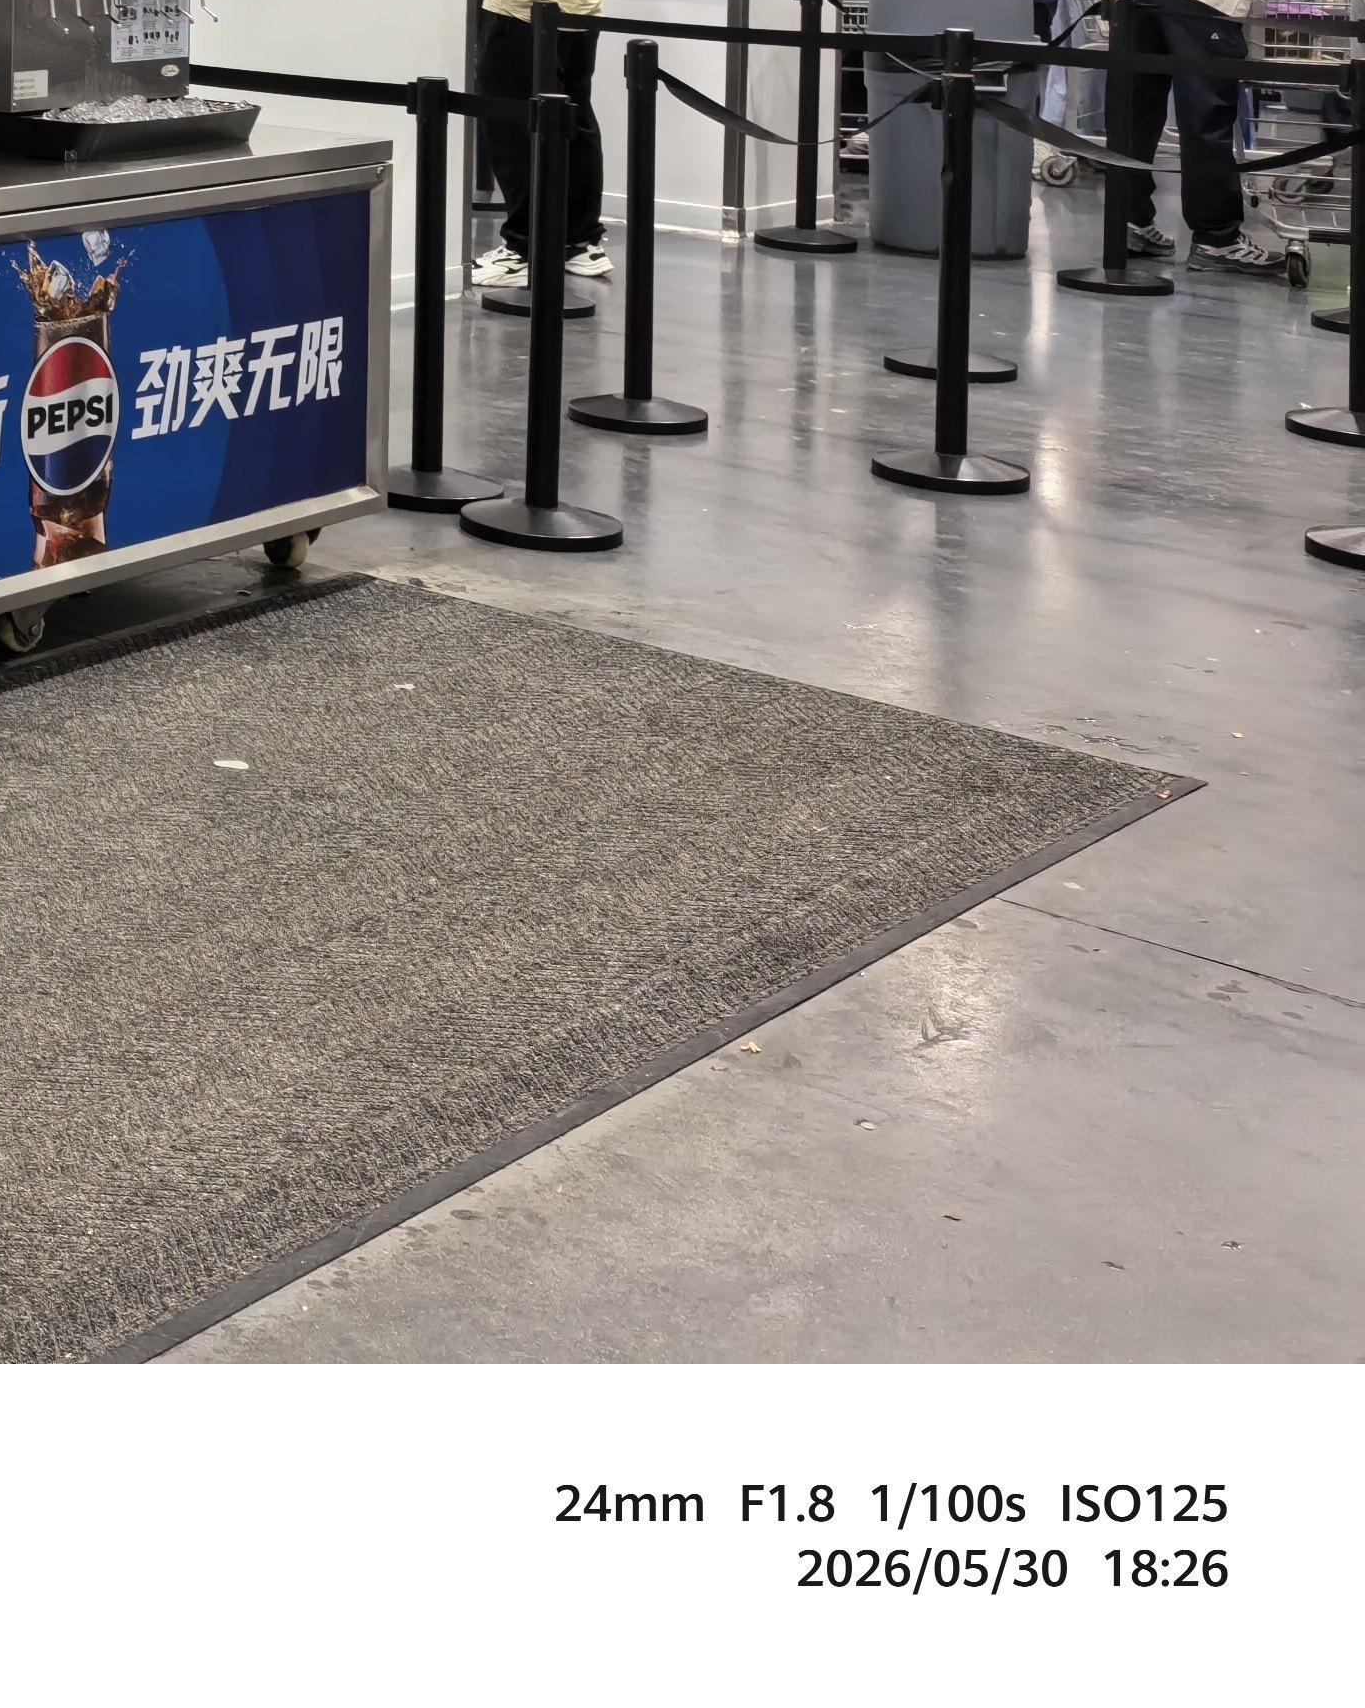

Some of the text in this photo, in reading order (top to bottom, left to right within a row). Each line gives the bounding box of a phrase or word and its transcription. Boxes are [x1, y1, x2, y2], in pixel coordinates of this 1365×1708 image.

[27, 397, 113, 439] PEPSI
[131, 316, 344, 440] 劲爽无限
